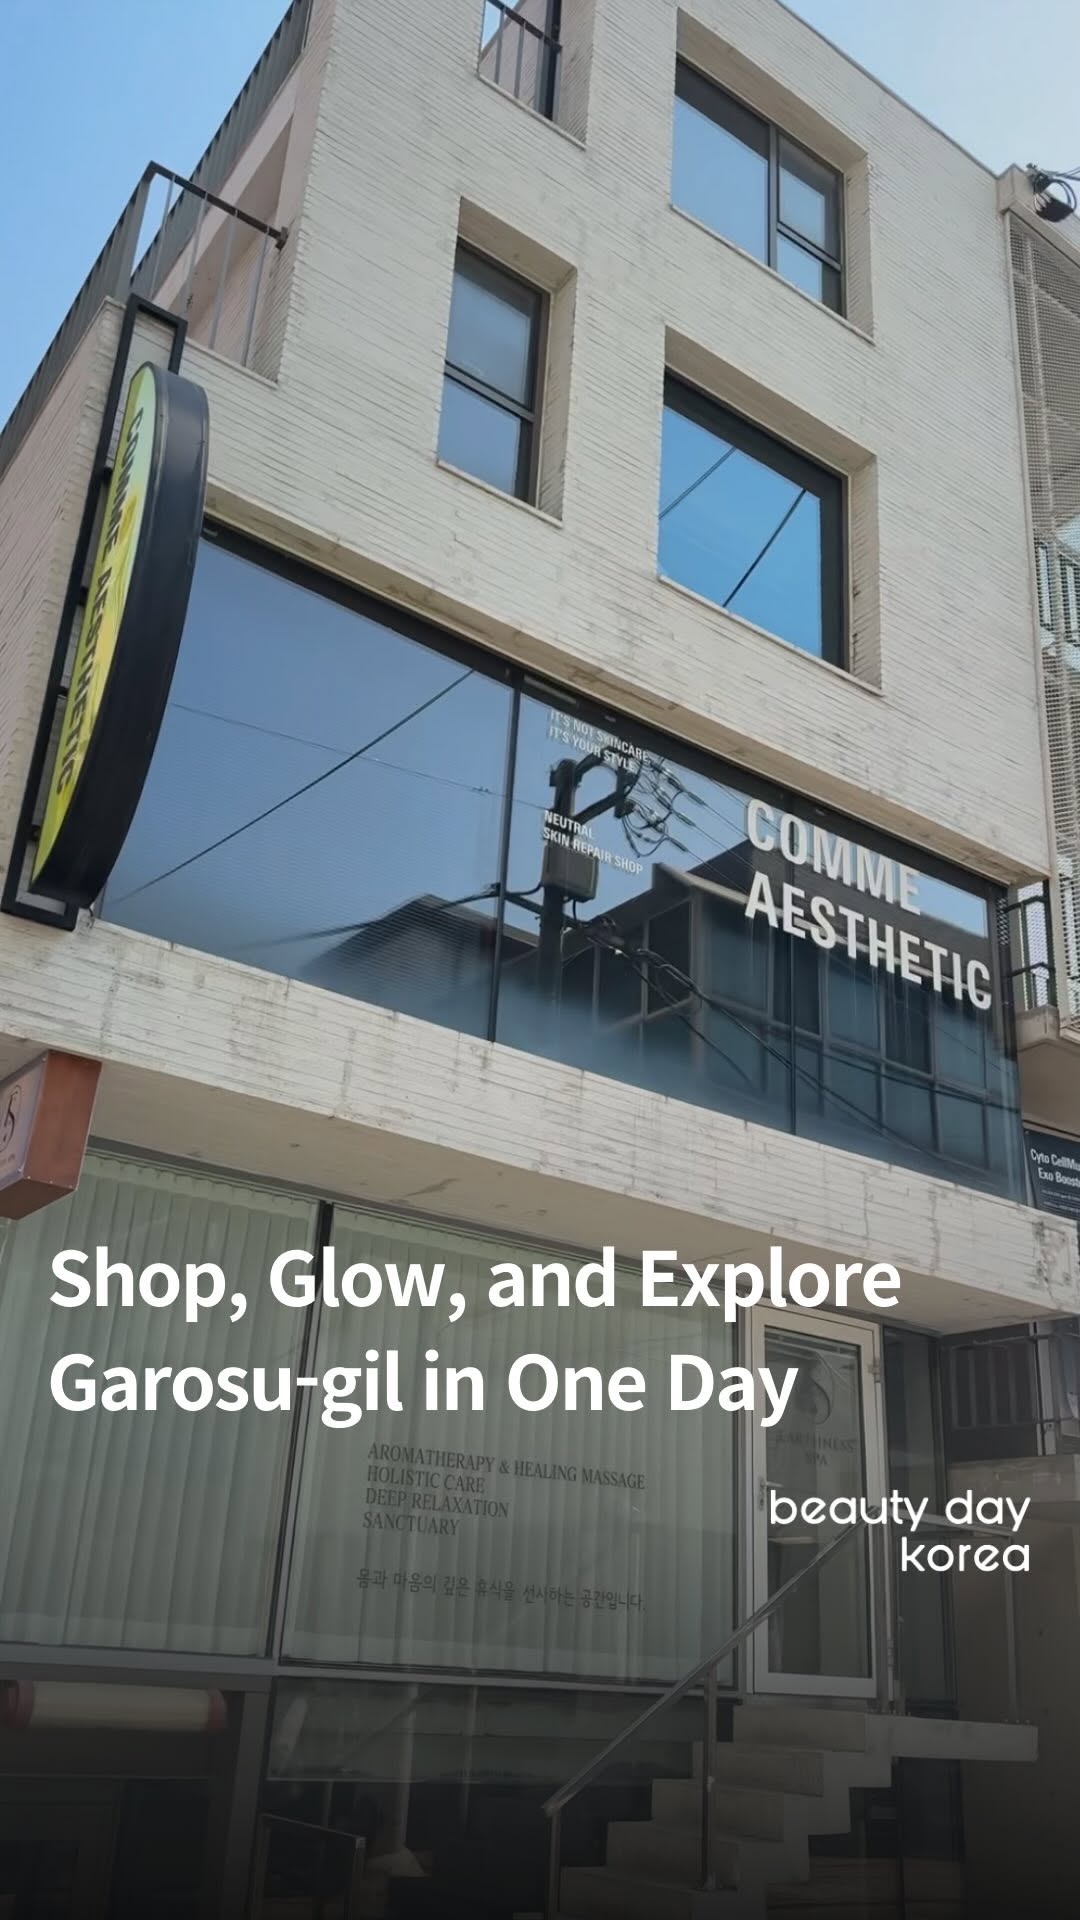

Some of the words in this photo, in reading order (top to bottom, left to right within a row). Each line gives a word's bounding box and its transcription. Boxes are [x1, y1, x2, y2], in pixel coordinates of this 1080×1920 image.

[101, 406, 144, 564] COMME
[56, 566, 113, 796] AESTHETIC
[550, 709, 571, 728] IT'S
[573, 719, 595, 739] NOT
[549, 725, 570, 744] IT'S
[572, 735, 601, 759] YOUR
[544, 810, 593, 838] NEUTRAL
[543, 828, 571, 847] SKIN
[573, 839, 612, 864] REPAIR
[614, 857, 644, 875] SHOP
[747, 799, 921, 916] COMME
[744, 870, 993, 1010] AESTHETIC
[1030, 1148, 1050, 1165] Cyto
[1038, 1167, 1054, 1182] Exo
[367, 1465, 441, 1488] HOLISTIC
[443, 1475, 485, 1493] CARE
[368, 1443, 496, 1473] AROMATHERAPY
[499, 1459, 510, 1475] &
[514, 1460, 578, 1482] HEALING
[581, 1467, 646, 1490] MASSAGE
[366, 1488, 408, 1506] DEEP
[411, 1494, 510, 1519] RELAXATION
[362, 1512, 461, 1536] SANCTUARY
[356, 1568, 387, 1590] 몸과
[393, 1573, 437, 1593] 마음의
[475, 1578, 516, 1602] 휴식을
[523, 1585, 576, 1608] 선사하는
[581, 1589, 646, 1612] 공간입니다.
